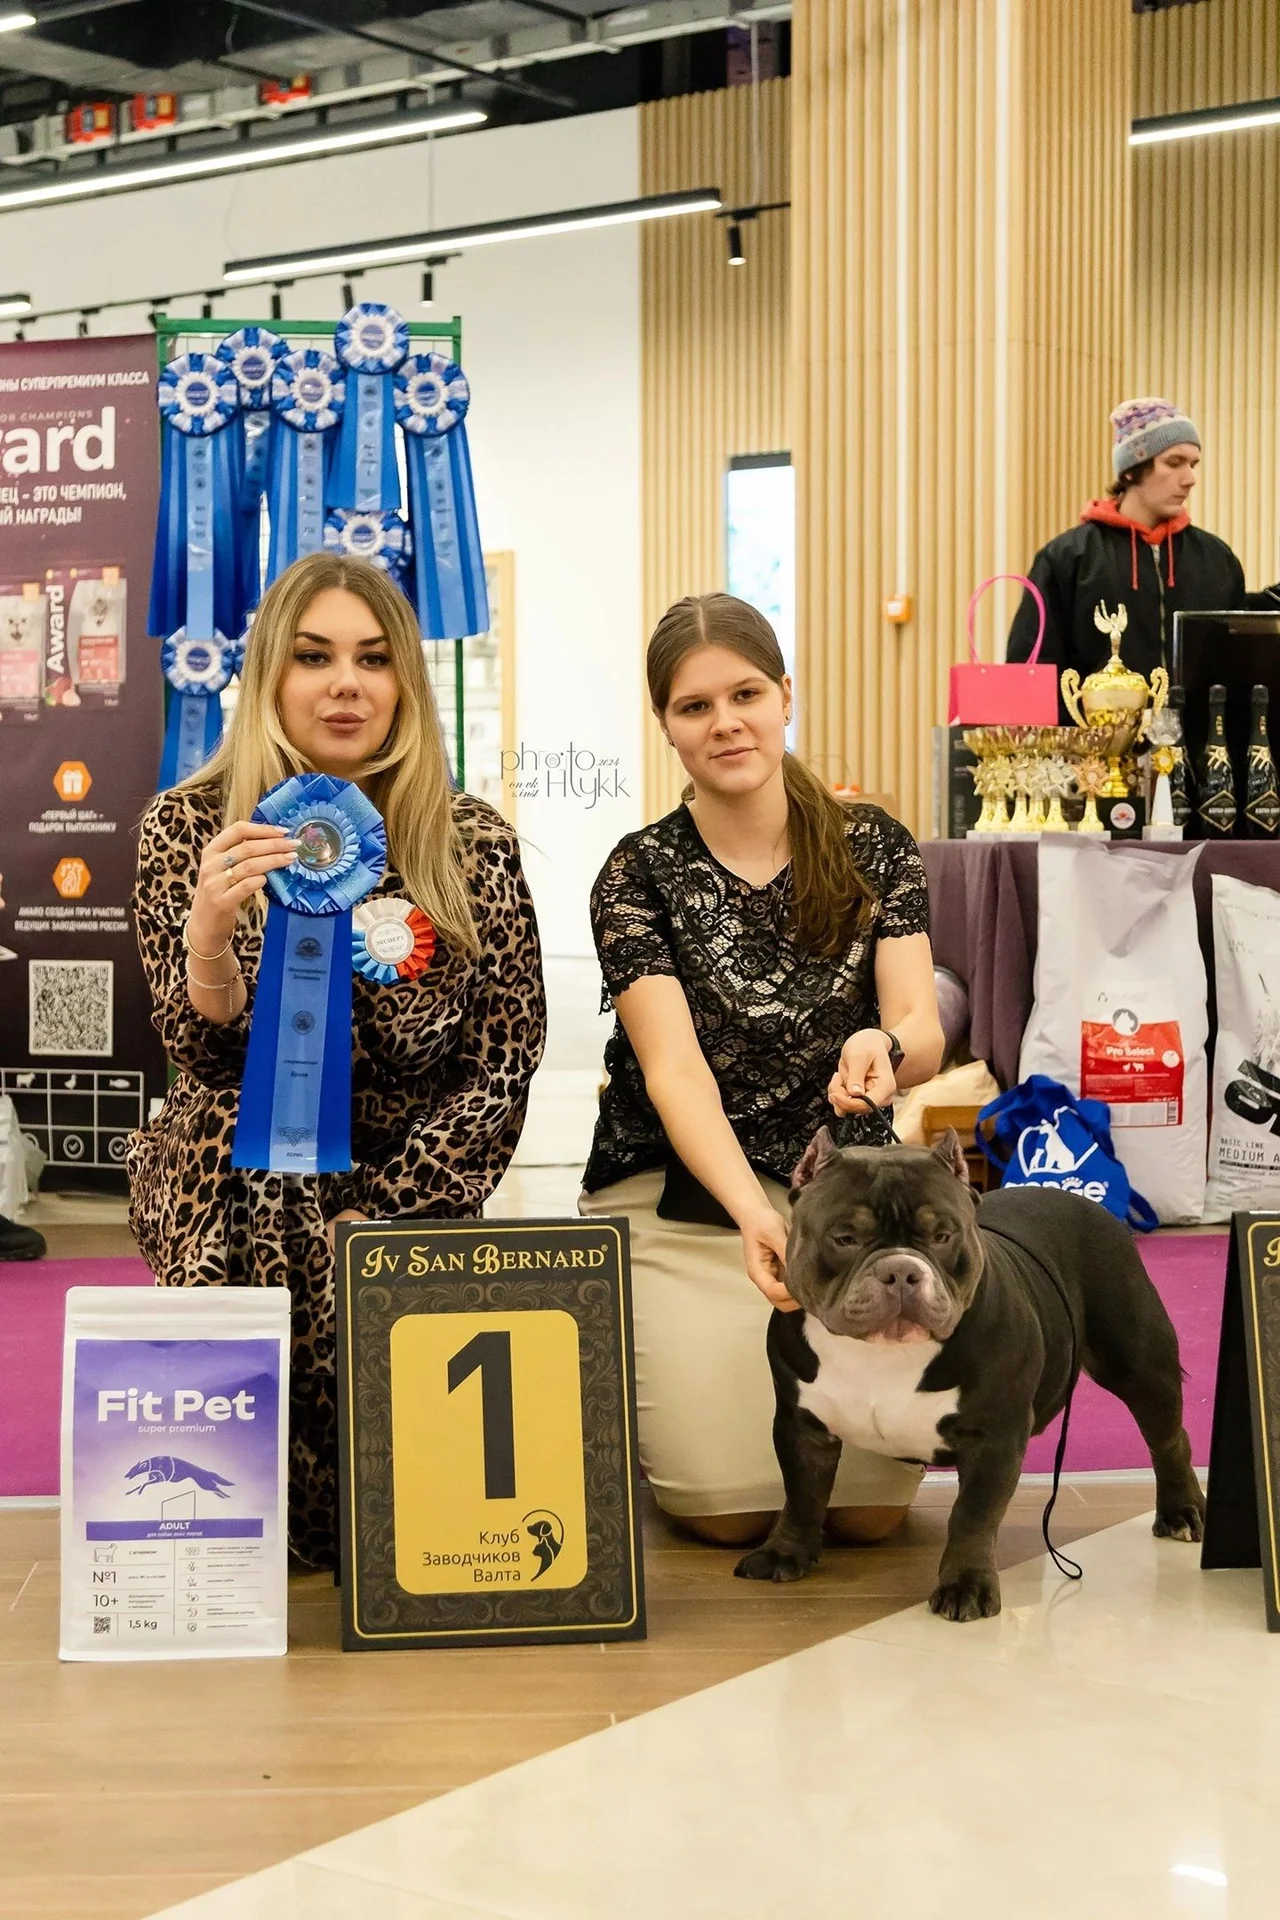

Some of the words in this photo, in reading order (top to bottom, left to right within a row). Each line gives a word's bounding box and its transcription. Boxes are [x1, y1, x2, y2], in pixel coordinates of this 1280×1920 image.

[20, 373, 106, 391] СУПЕРПРЕМИУМ
[107, 371, 150, 387] КЛАССА
[20, 409, 93, 421] CHAMPIONS
[0, 406, 116, 474] ard
[33, 485, 57, 502] ЭТО
[60, 482, 127, 501] ЧЕМПИОН,
[16, 506, 82, 526] НАГРАДЫ!
[45, 584, 65, 674] Award
[1105, 1046, 1123, 1057] Pro
[1125, 1046, 1155, 1056] Select
[1219, 1147, 1264, 1162] MEDIUM
[407, 1245, 465, 1276] SAN
[97, 1387, 163, 1422] Fit
[173, 1389, 256, 1421] Pet
[447, 1330, 516, 1500] 1
[137, 1424, 167, 1434] super
[169, 1423, 216, 1434] premium
[159, 1522, 190, 1530] ADULT
[479, 1528, 520, 1547] Клуб
[422, 1551, 521, 1567] Заводчиков
[473, 1568, 521, 1582] Валта
[93, 1594, 119, 1607] 10+
[129, 1620, 142, 1630] 1,5
[143, 1620, 158, 1630] kg
